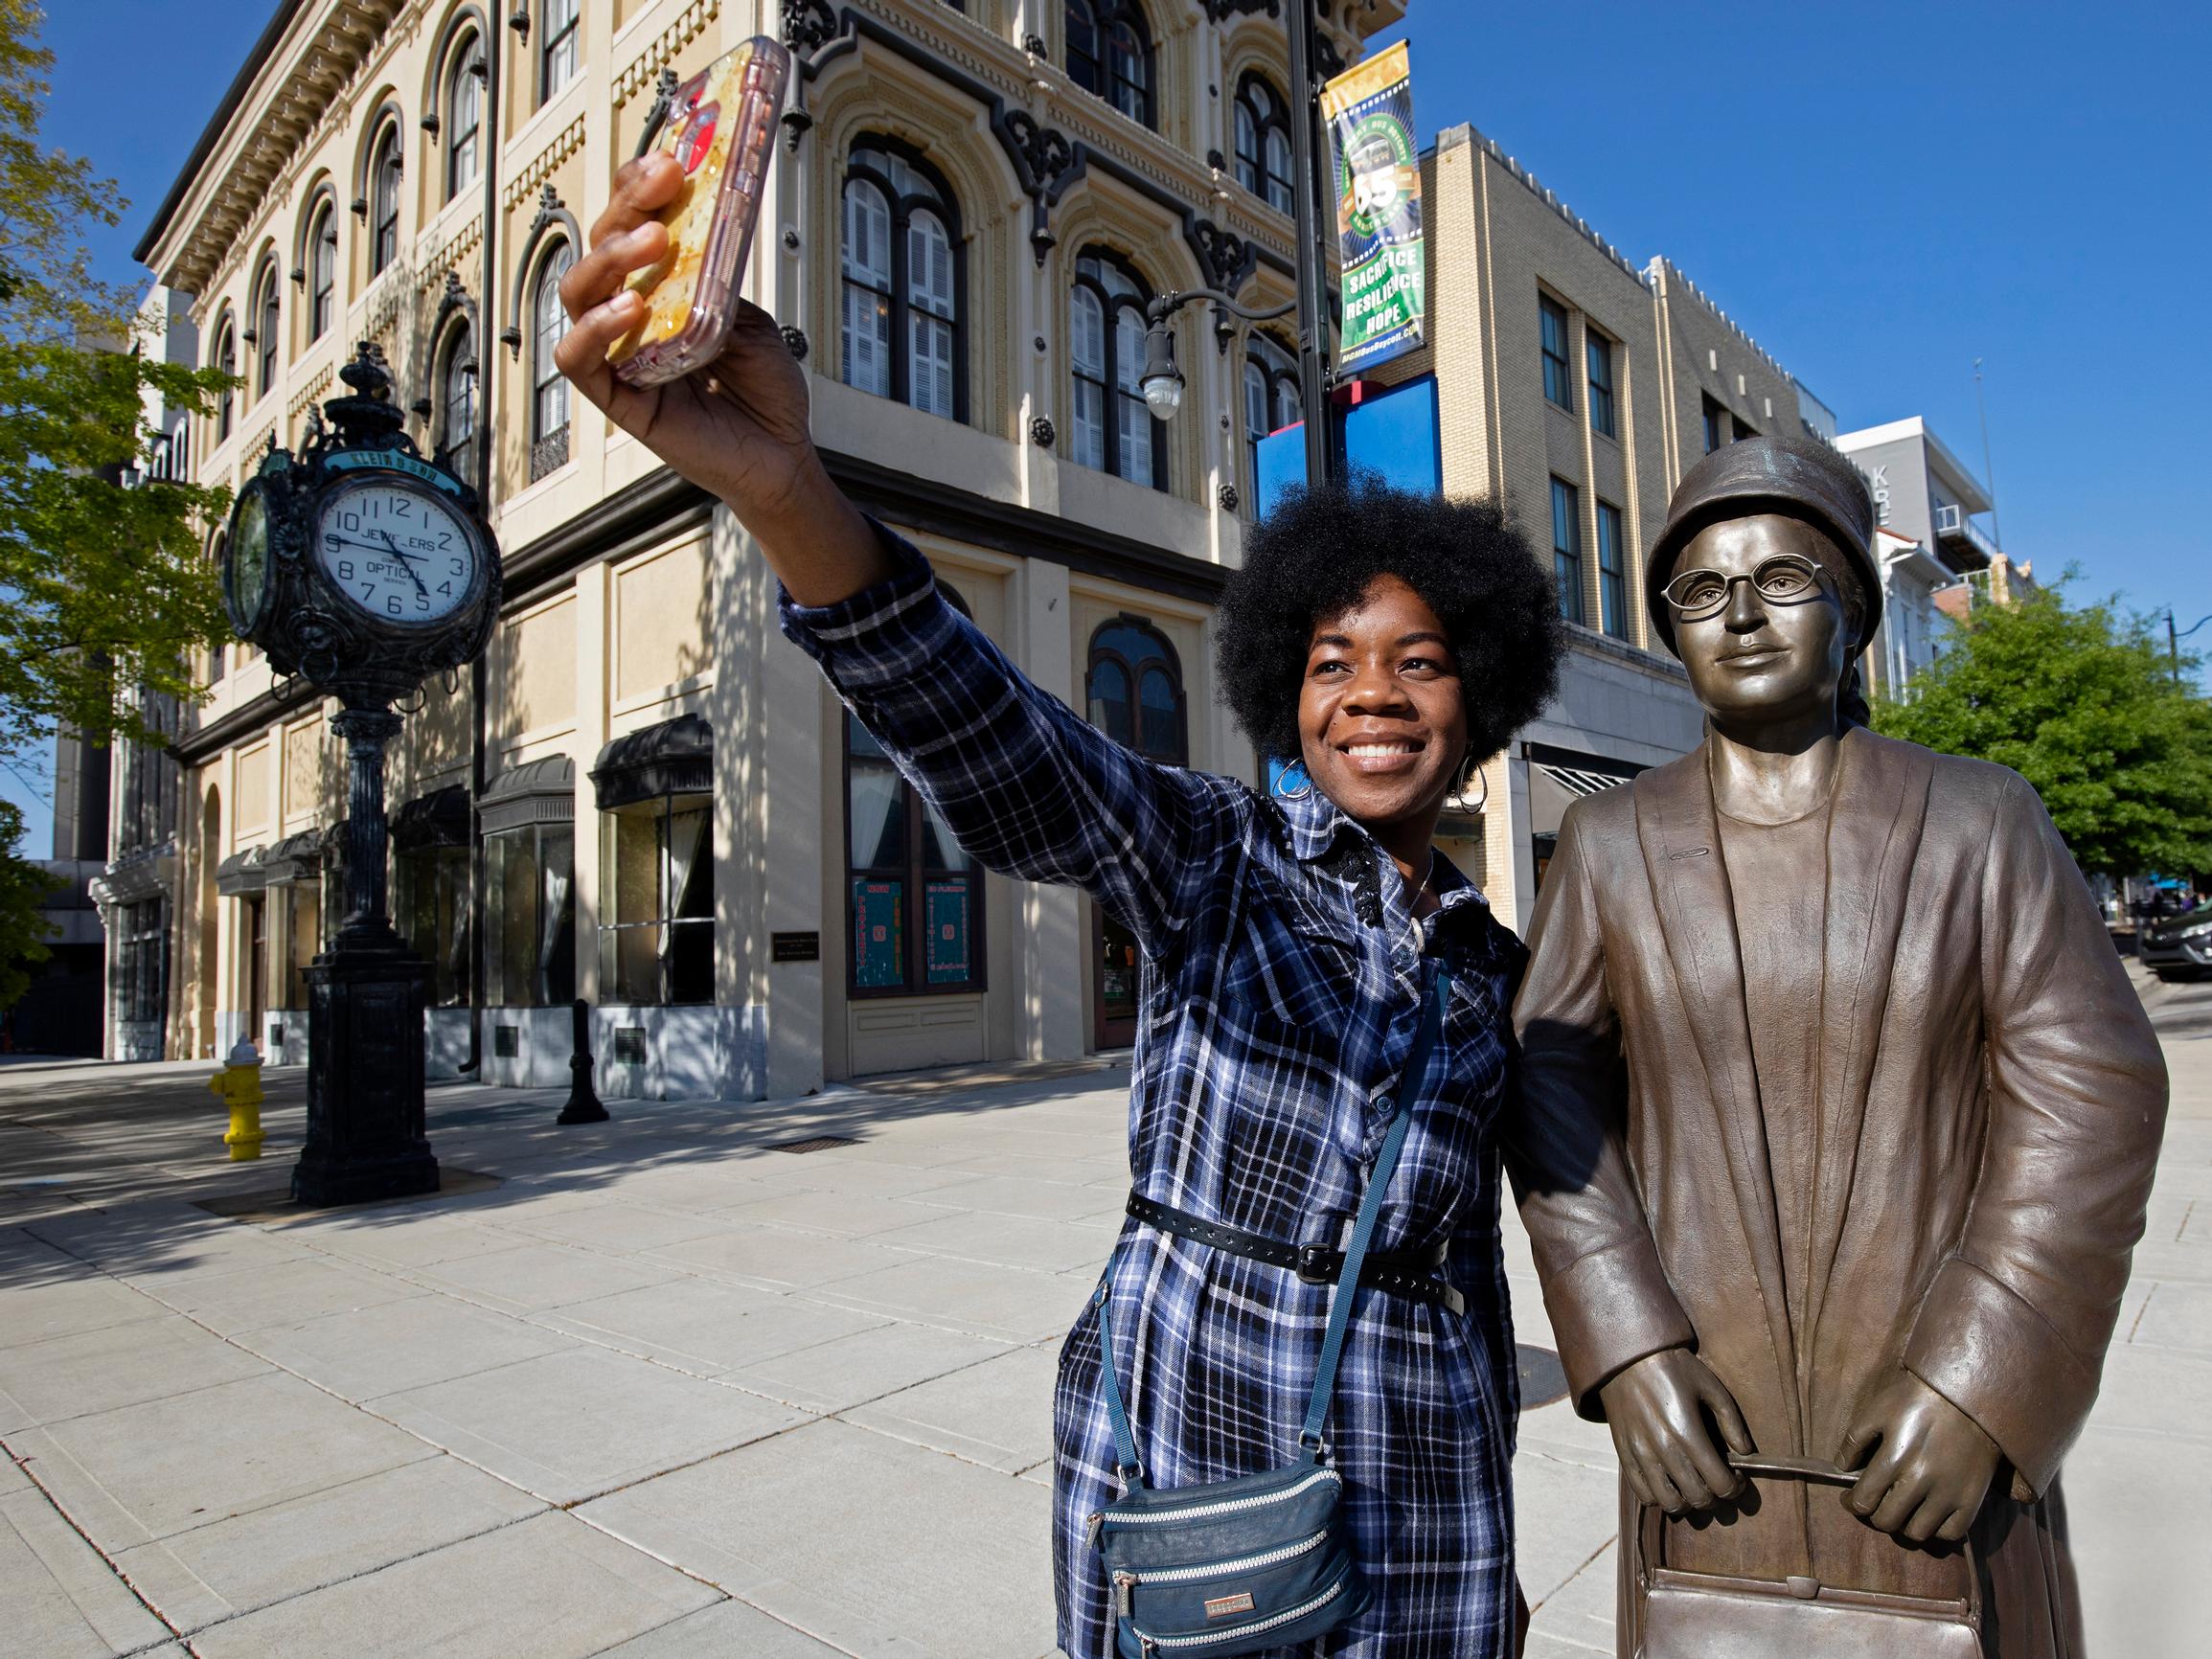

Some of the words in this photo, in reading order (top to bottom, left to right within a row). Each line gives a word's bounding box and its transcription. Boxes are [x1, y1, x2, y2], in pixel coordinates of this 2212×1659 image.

[1349, 248, 1417, 294] SACRIFICE
[1346, 271, 1422, 321] RESILIENCE
[1366, 303, 1401, 335] HOPE
[362, 498, 378, 519] 11
[389, 496, 411, 518] 12
[336, 511, 359, 533] 10
[423, 511, 428, 530] 1
[326, 533, 341, 553] 9
[438, 532, 452, 552] 2
[338, 560, 353, 580] 8
[449, 557, 464, 577] 3
[360, 581, 376, 602] 7
[436, 580, 452, 598] 4
[387, 595, 402, 615] 6
[415, 591, 430, 611] 5
